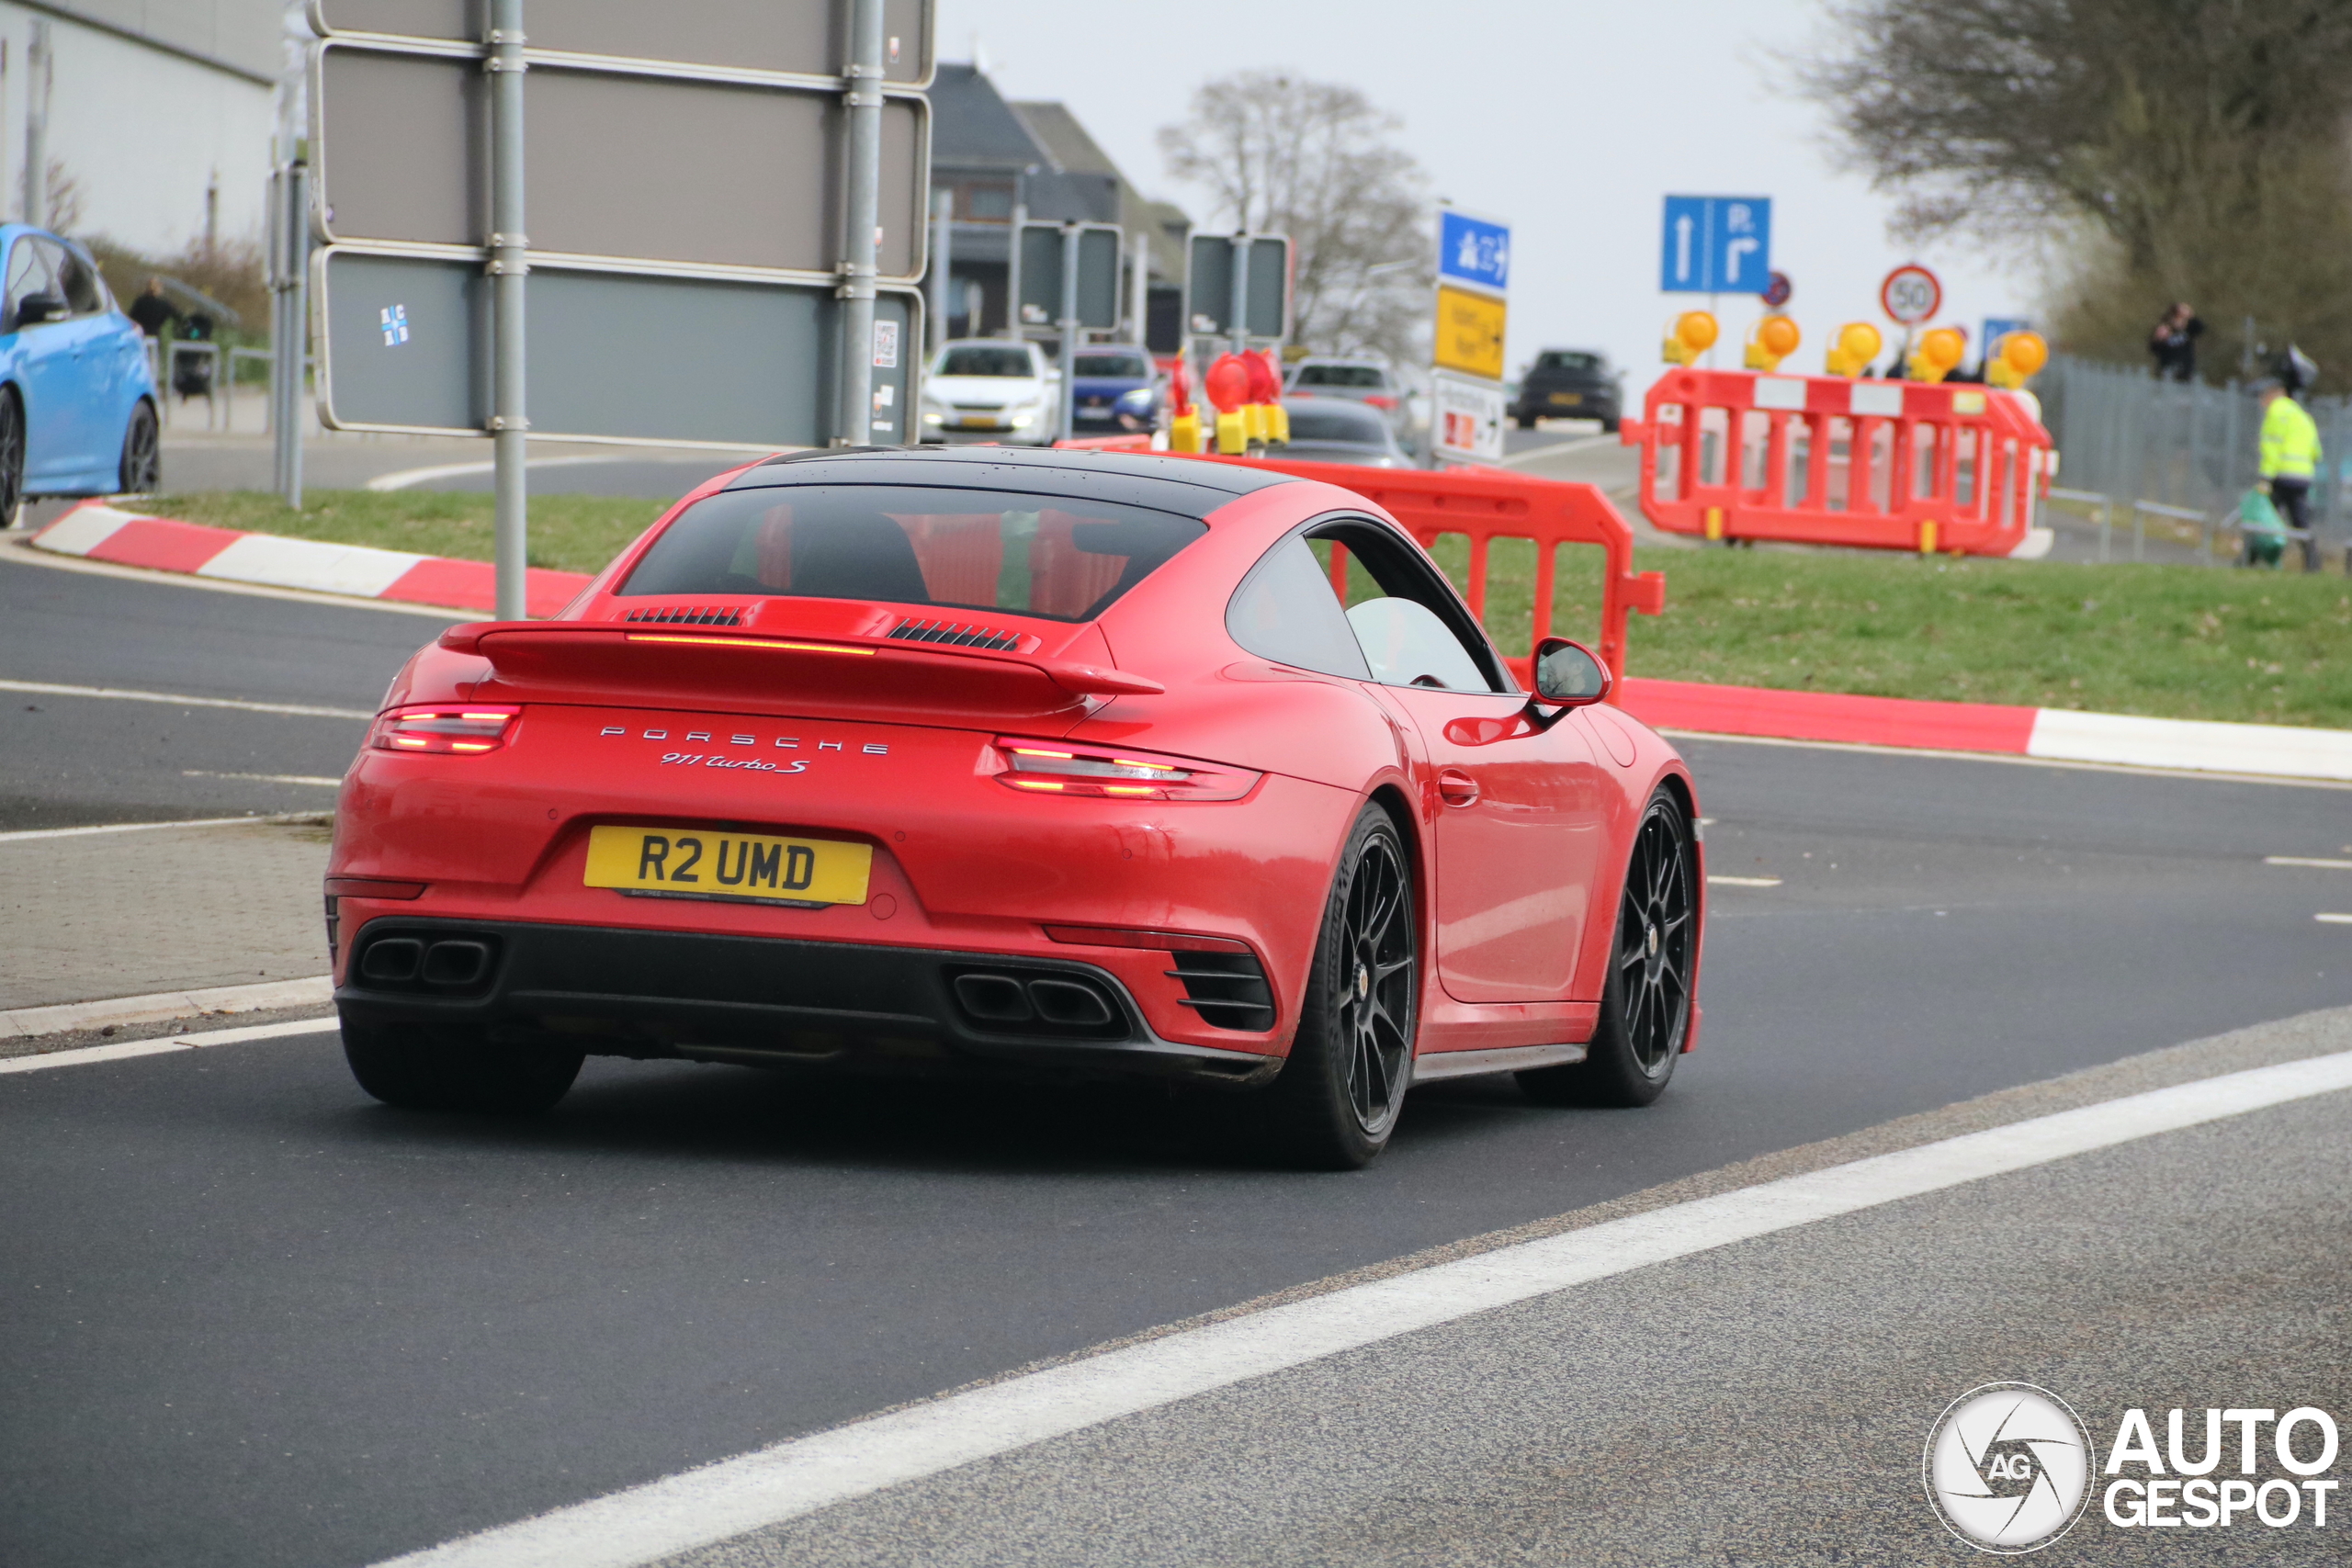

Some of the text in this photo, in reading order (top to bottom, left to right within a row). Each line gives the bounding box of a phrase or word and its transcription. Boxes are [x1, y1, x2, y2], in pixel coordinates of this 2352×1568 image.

[1893, 281, 1927, 310] 50
[600, 727, 888, 754] PORSCHE
[661, 752, 810, 773] 911 turbo S
[638, 835, 815, 891] R2 UMD
